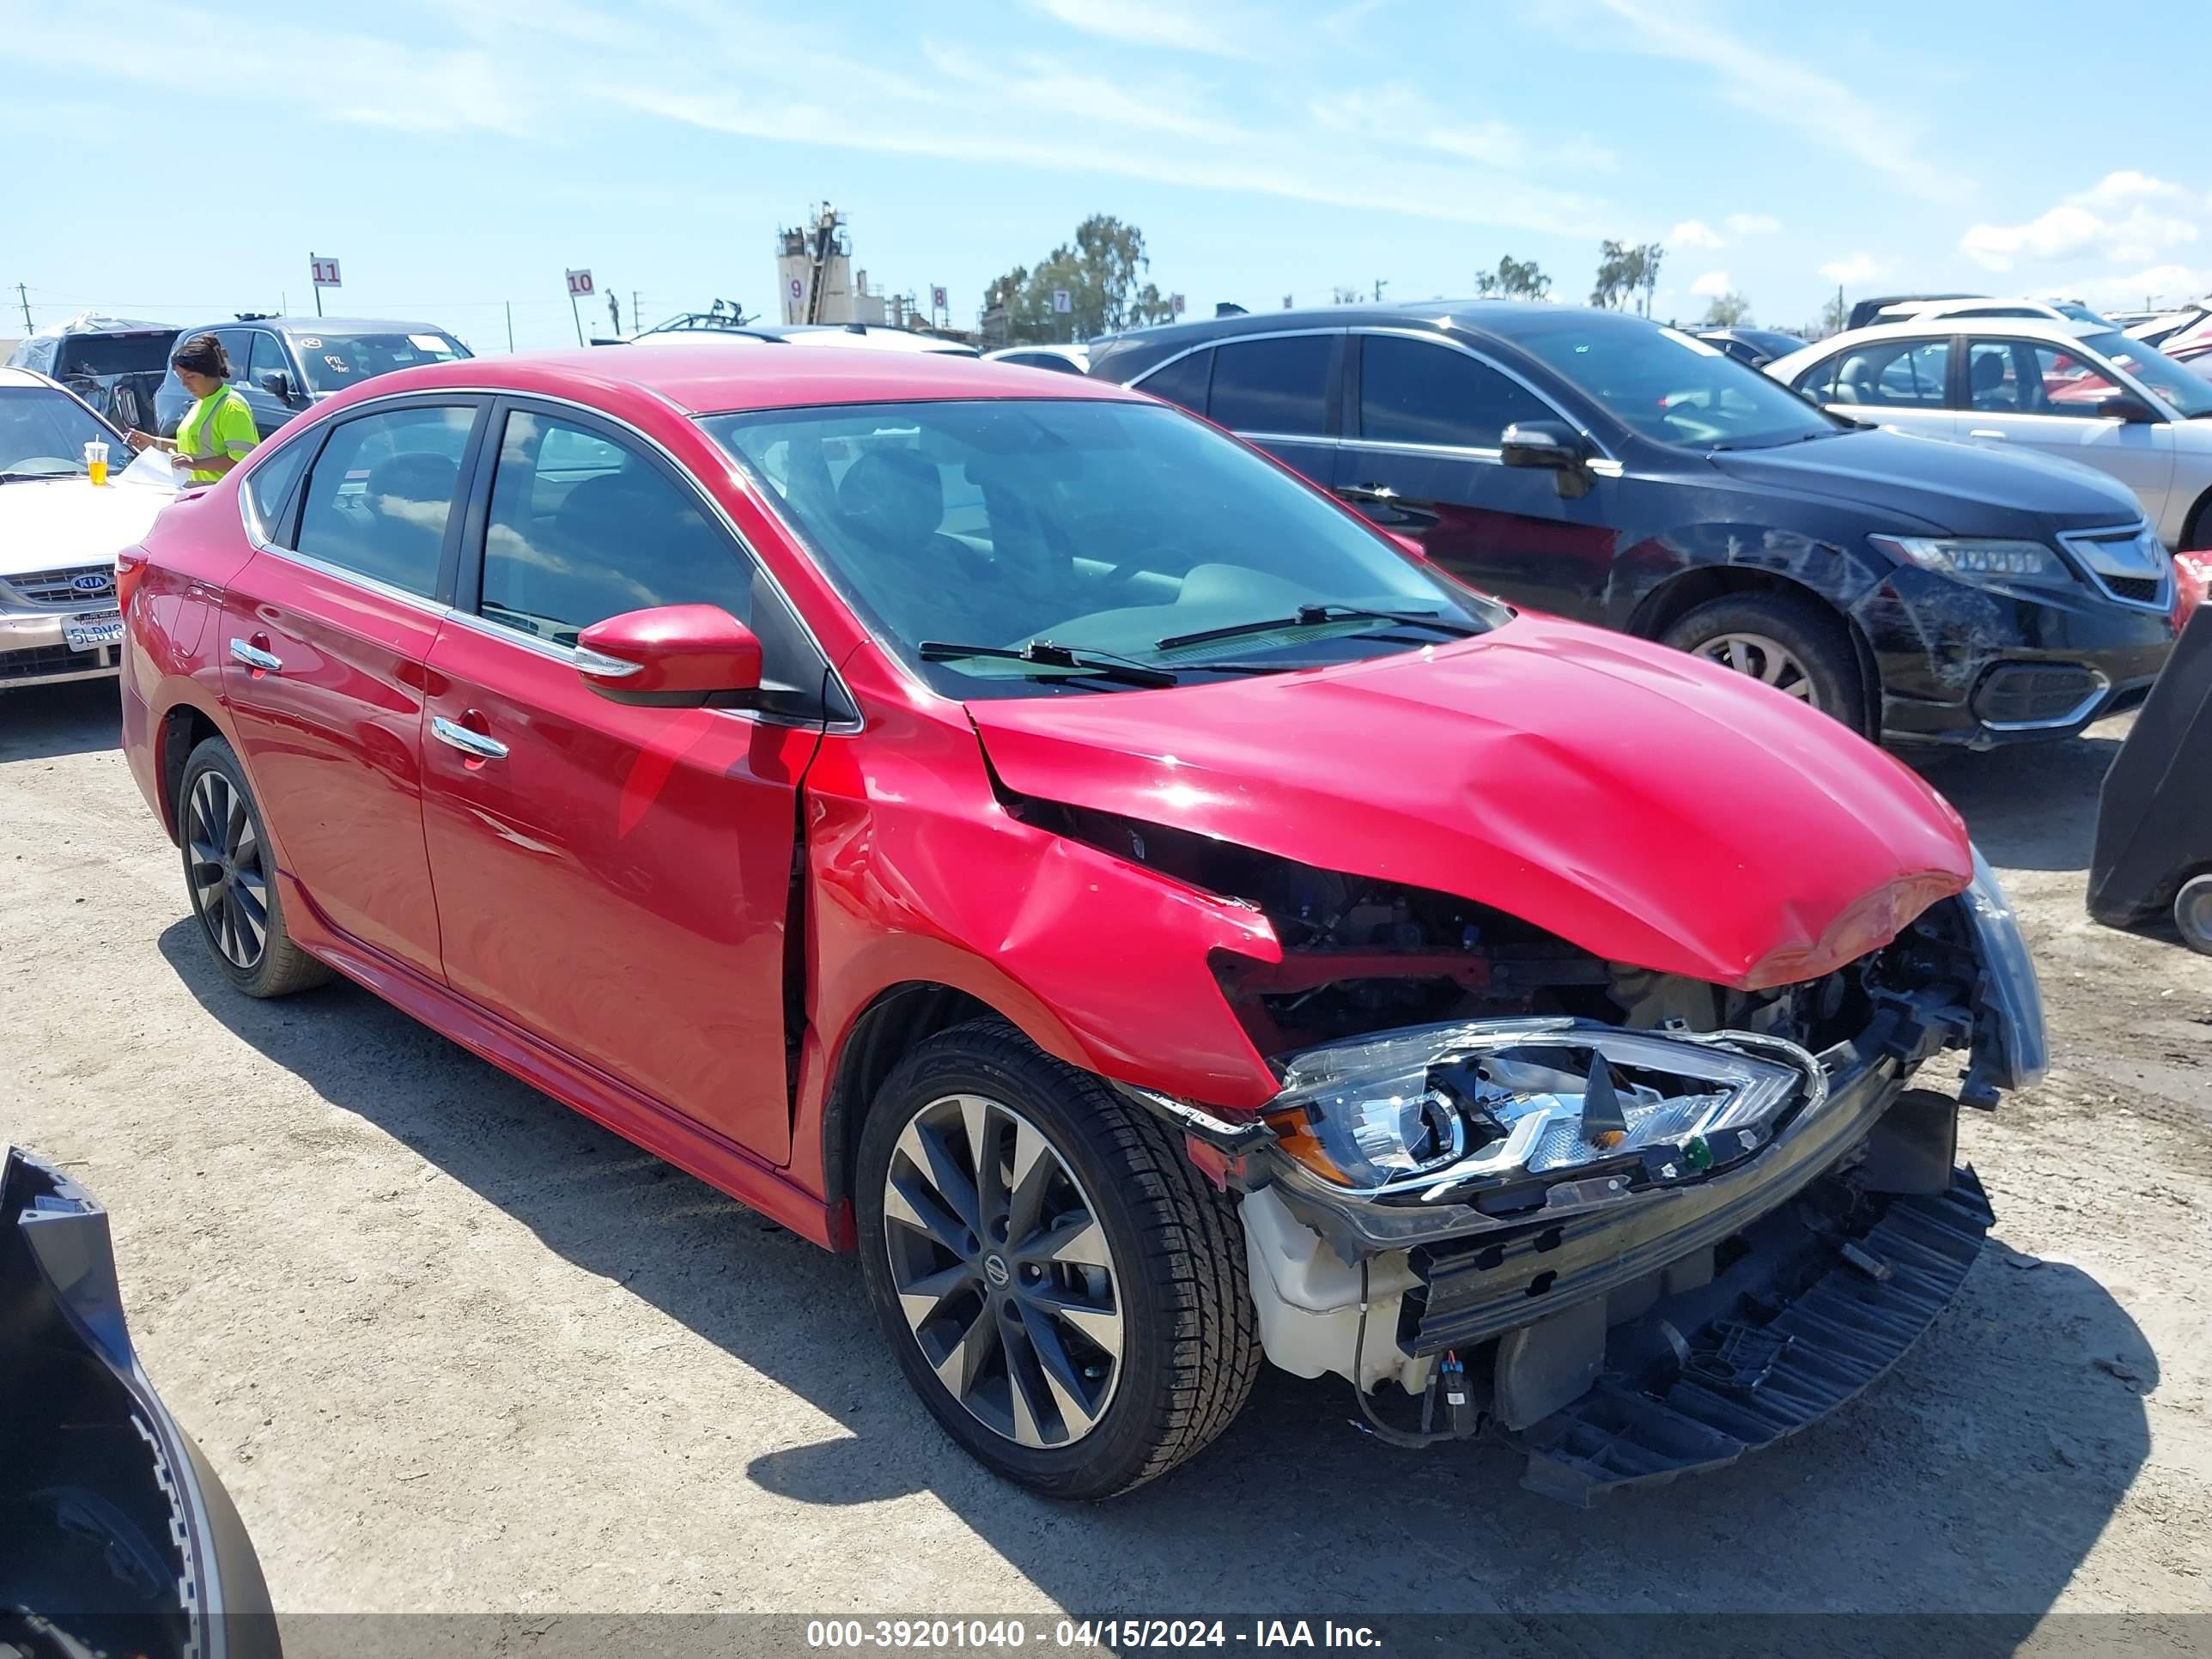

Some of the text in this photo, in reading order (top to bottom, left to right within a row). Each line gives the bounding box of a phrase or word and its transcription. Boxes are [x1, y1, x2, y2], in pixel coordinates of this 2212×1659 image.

[312, 261, 340, 283] 11
[568, 274, 592, 293] 10
[791, 279, 801, 299] 9
[934, 289, 944, 307] 8
[1056, 293, 1066, 310] 7
[78, 577, 104, 588] KIA
